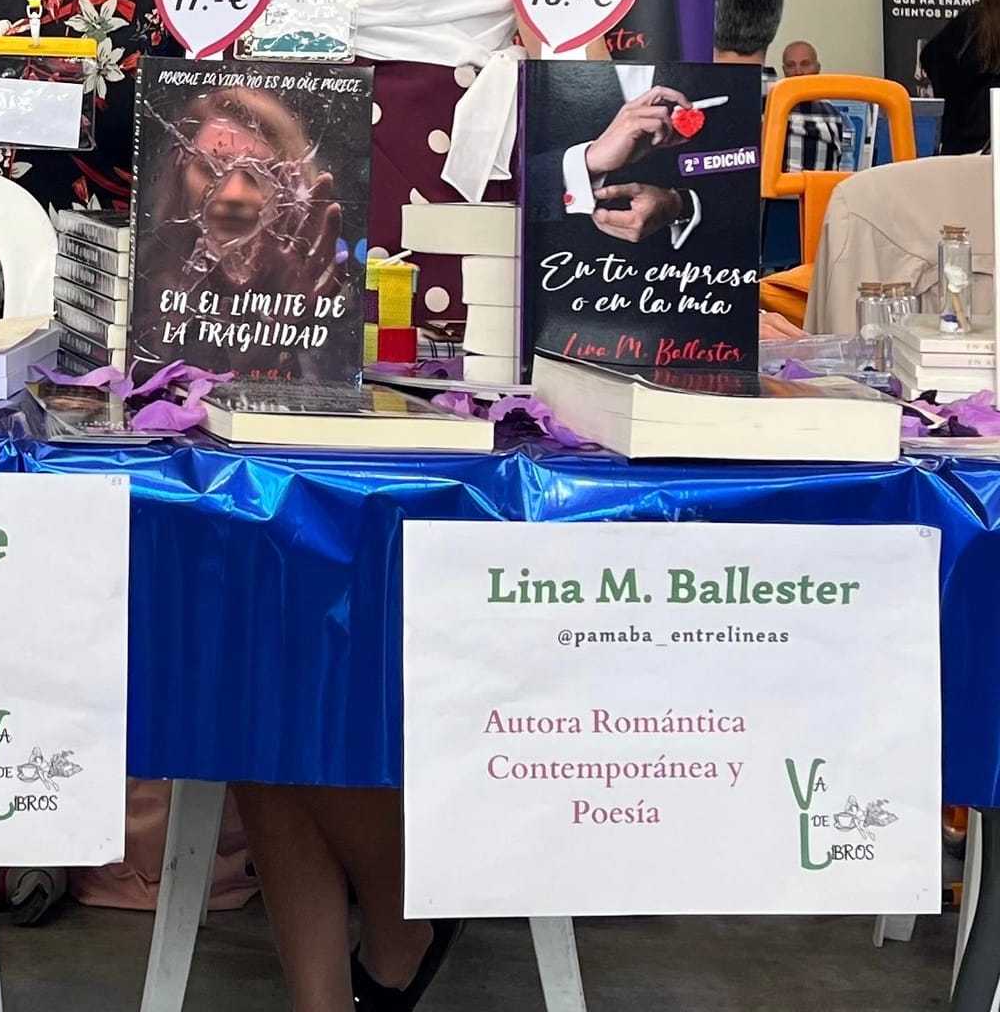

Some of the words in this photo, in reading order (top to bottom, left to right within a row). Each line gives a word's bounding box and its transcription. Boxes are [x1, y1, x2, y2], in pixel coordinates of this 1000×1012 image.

[158, 70, 202, 86] PORQUE
[215, 72, 246, 87] VIDA
[247, 75, 262, 88] NO
[264, 75, 280, 89] ES
[297, 76, 320, 92] QUE
[703, 148, 756, 170] EDICIÓN
[540, 251, 596, 291] En
[596, 253, 638, 283] tu
[644, 261, 761, 292] empresa
[160, 289, 187, 314] EN
[199, 291, 221, 315] EL
[231, 289, 306, 316] LÍMITE
[314, 294, 346, 318] DE
[571, 296, 589, 311] o
[594, 293, 631, 312] en
[639, 287, 672, 314] la
[678, 292, 732, 315] mía
[163, 321, 187, 345] LA
[199, 321, 328, 352] FRAGILIDAD
[563, 332, 608, 358] Lina
[615, 334, 648, 359] M.
[655, 338, 744, 366] Ballester
[487, 567, 584, 604] Lina
[595, 567, 652, 605] M.
[667, 566, 860, 605] Ballester
[483, 708, 582, 734] Autora
[591, 708, 746, 734] Romántica
[486, 754, 717, 787] Contemporánea
[727, 760, 744, 787] y
[571, 798, 661, 826] Poesía
[811, 814, 830, 828] DE
